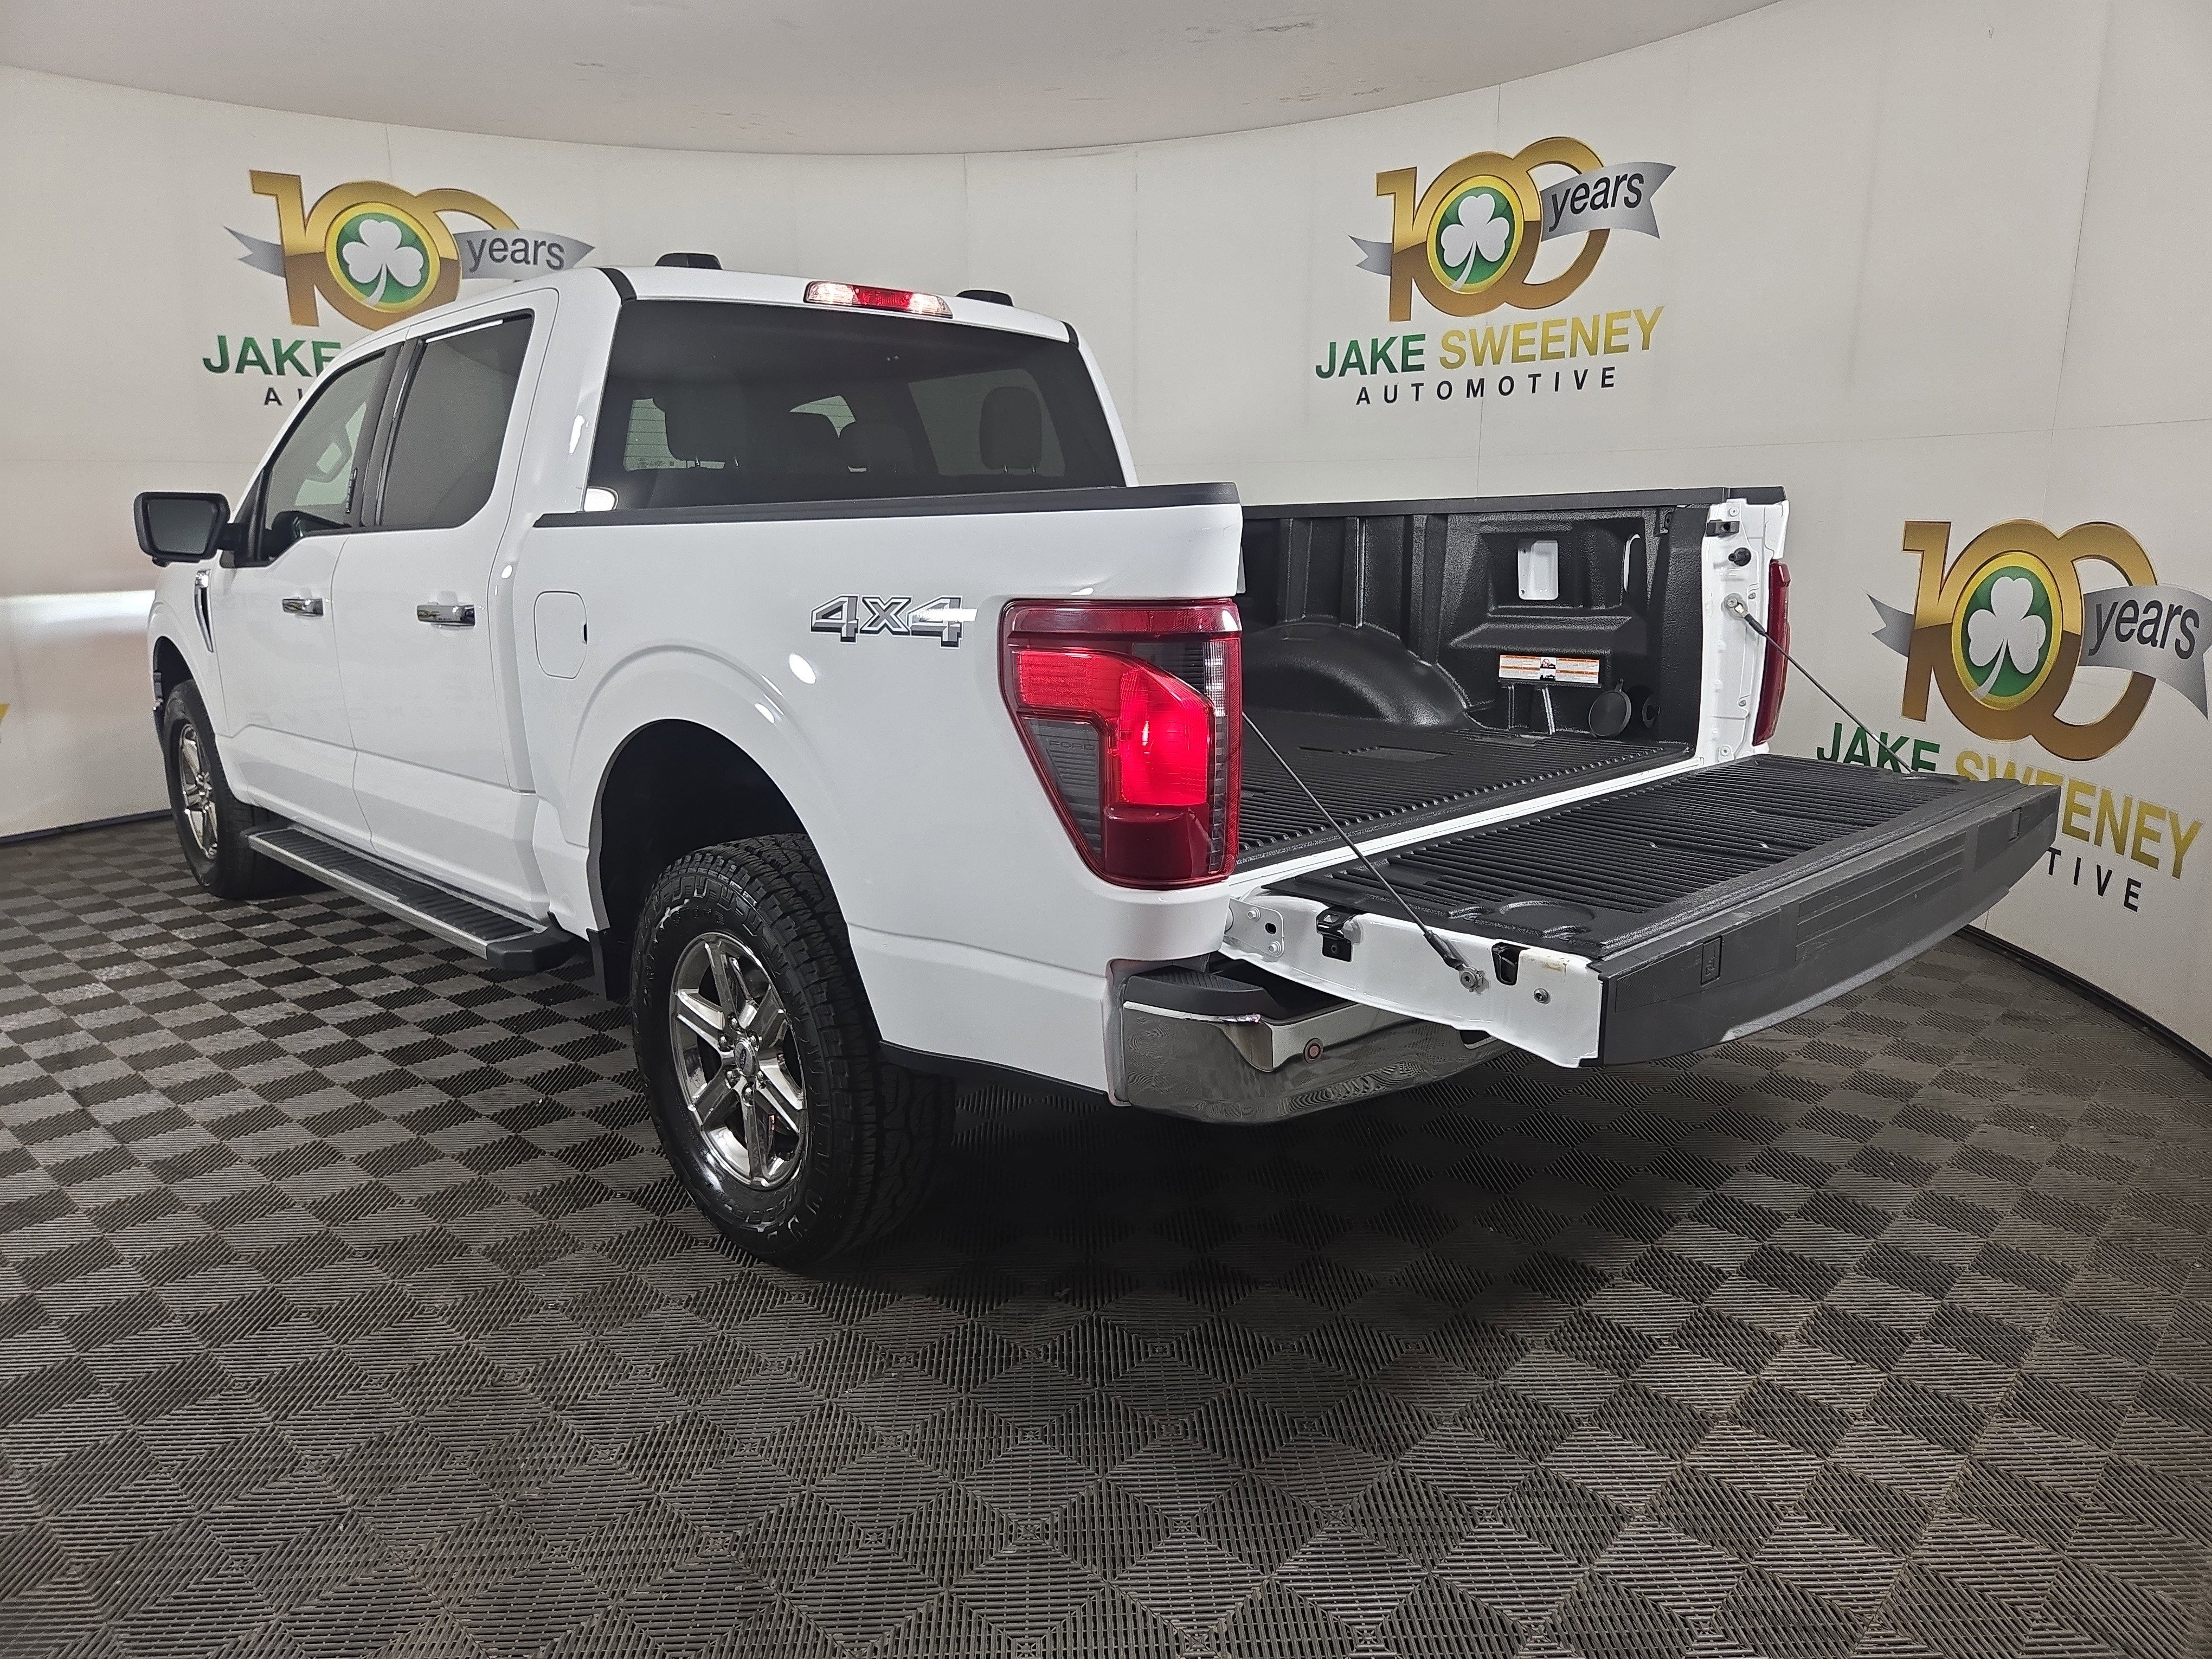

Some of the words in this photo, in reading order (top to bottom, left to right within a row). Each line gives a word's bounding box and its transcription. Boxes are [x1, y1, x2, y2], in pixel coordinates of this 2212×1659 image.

[1376, 136, 1611, 321] 100
[1549, 171, 1645, 233] years
[467, 237, 565, 271] years
[203, 335, 342, 377] JAKE
[1315, 333, 1426, 379] JAKE
[1439, 305, 1664, 370] SWEENEY
[1356, 366, 1616, 406] AUTOMOTIVE
[1902, 519, 2158, 761] 100
[2088, 599, 2200, 660] years
[1049, 740, 1095, 750] FORD
[1816, 722, 1940, 773] JAKE
